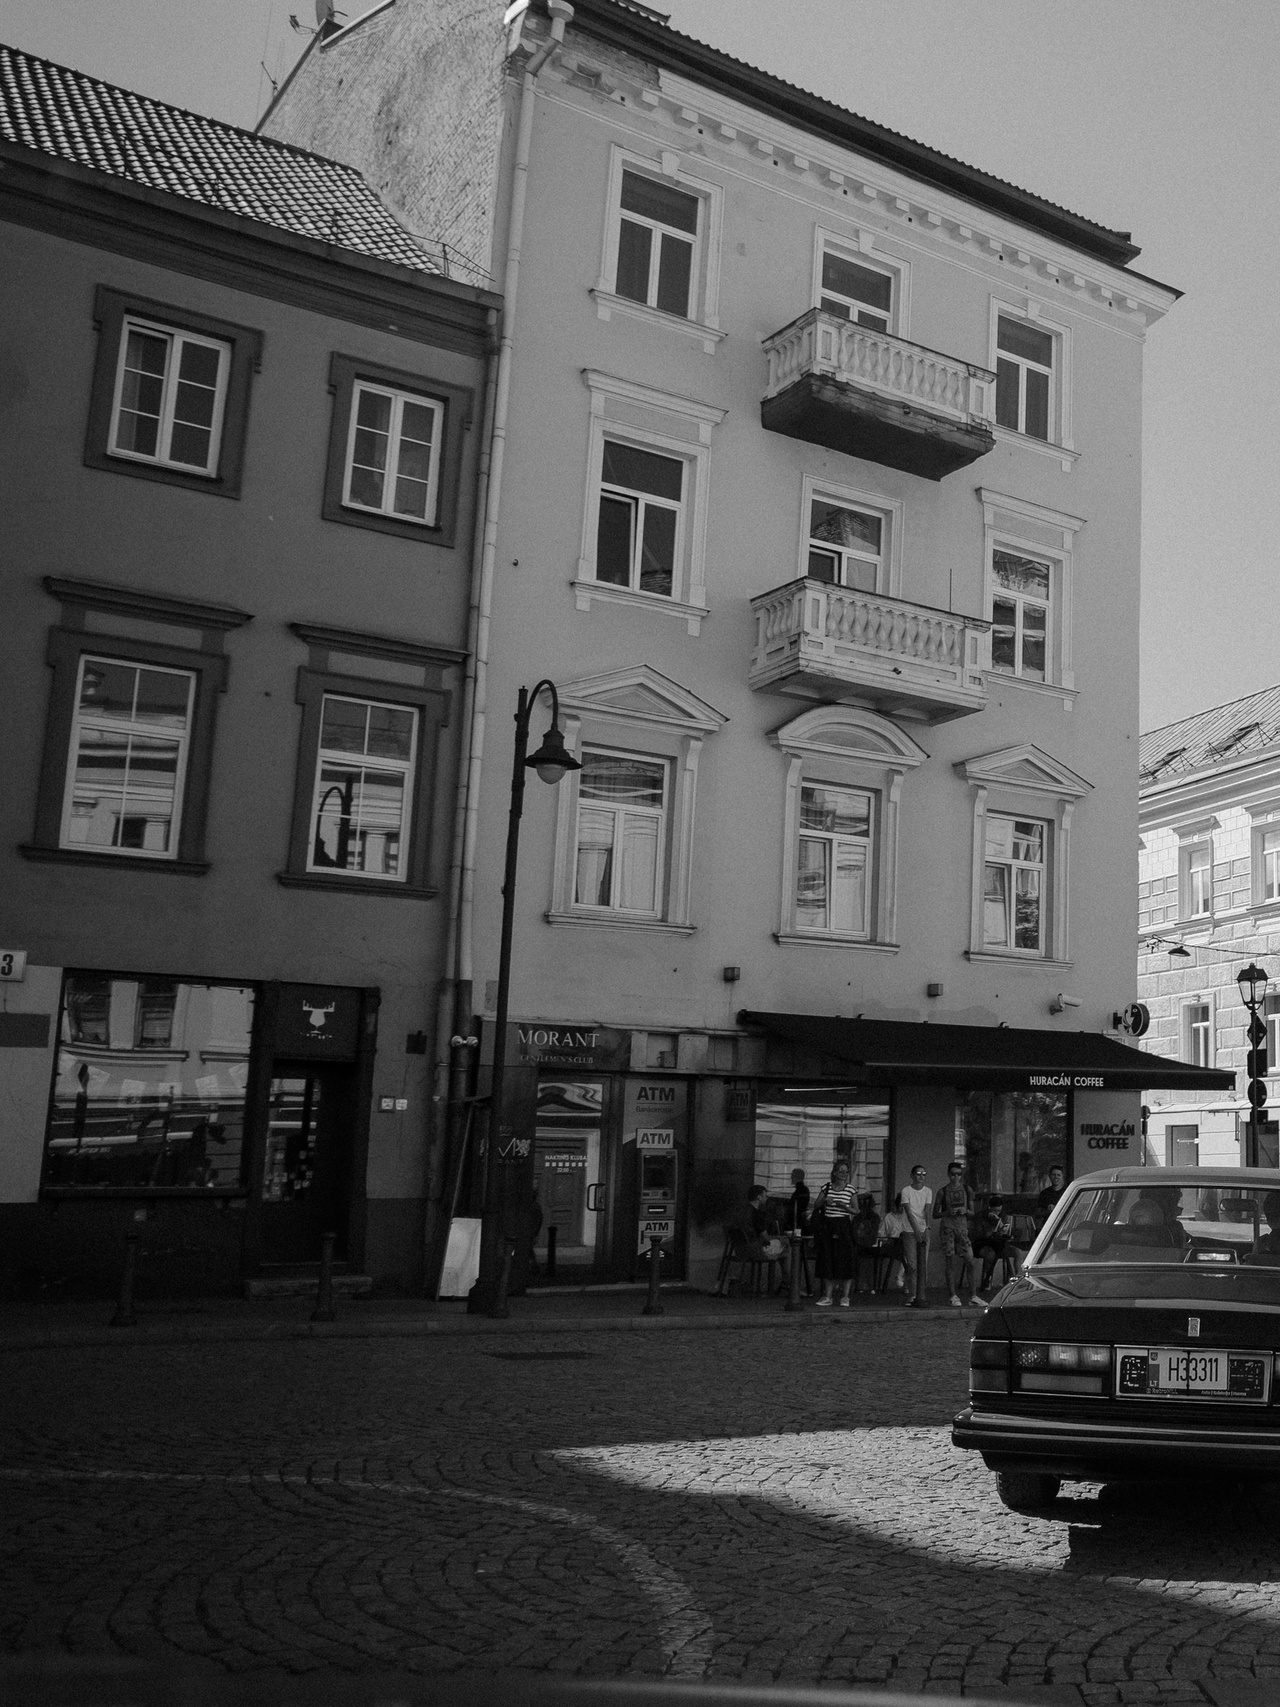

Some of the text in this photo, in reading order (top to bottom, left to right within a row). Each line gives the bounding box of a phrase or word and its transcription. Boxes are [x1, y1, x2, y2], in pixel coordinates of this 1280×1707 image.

[518, 1029, 600, 1048] MORANT
[573, 1056, 594, 1064] CLUB
[1029, 1072, 1105, 1087] HURACÁN COFFEE
[636, 1086, 675, 1102] ATM
[1080, 1119, 1135, 1136] HURACÁN
[639, 1132, 671, 1145] ATM
[1087, 1137, 1130, 1149] COFFEE
[644, 1221, 669, 1232] ATM
[1167, 1356, 1220, 1382] H33311
